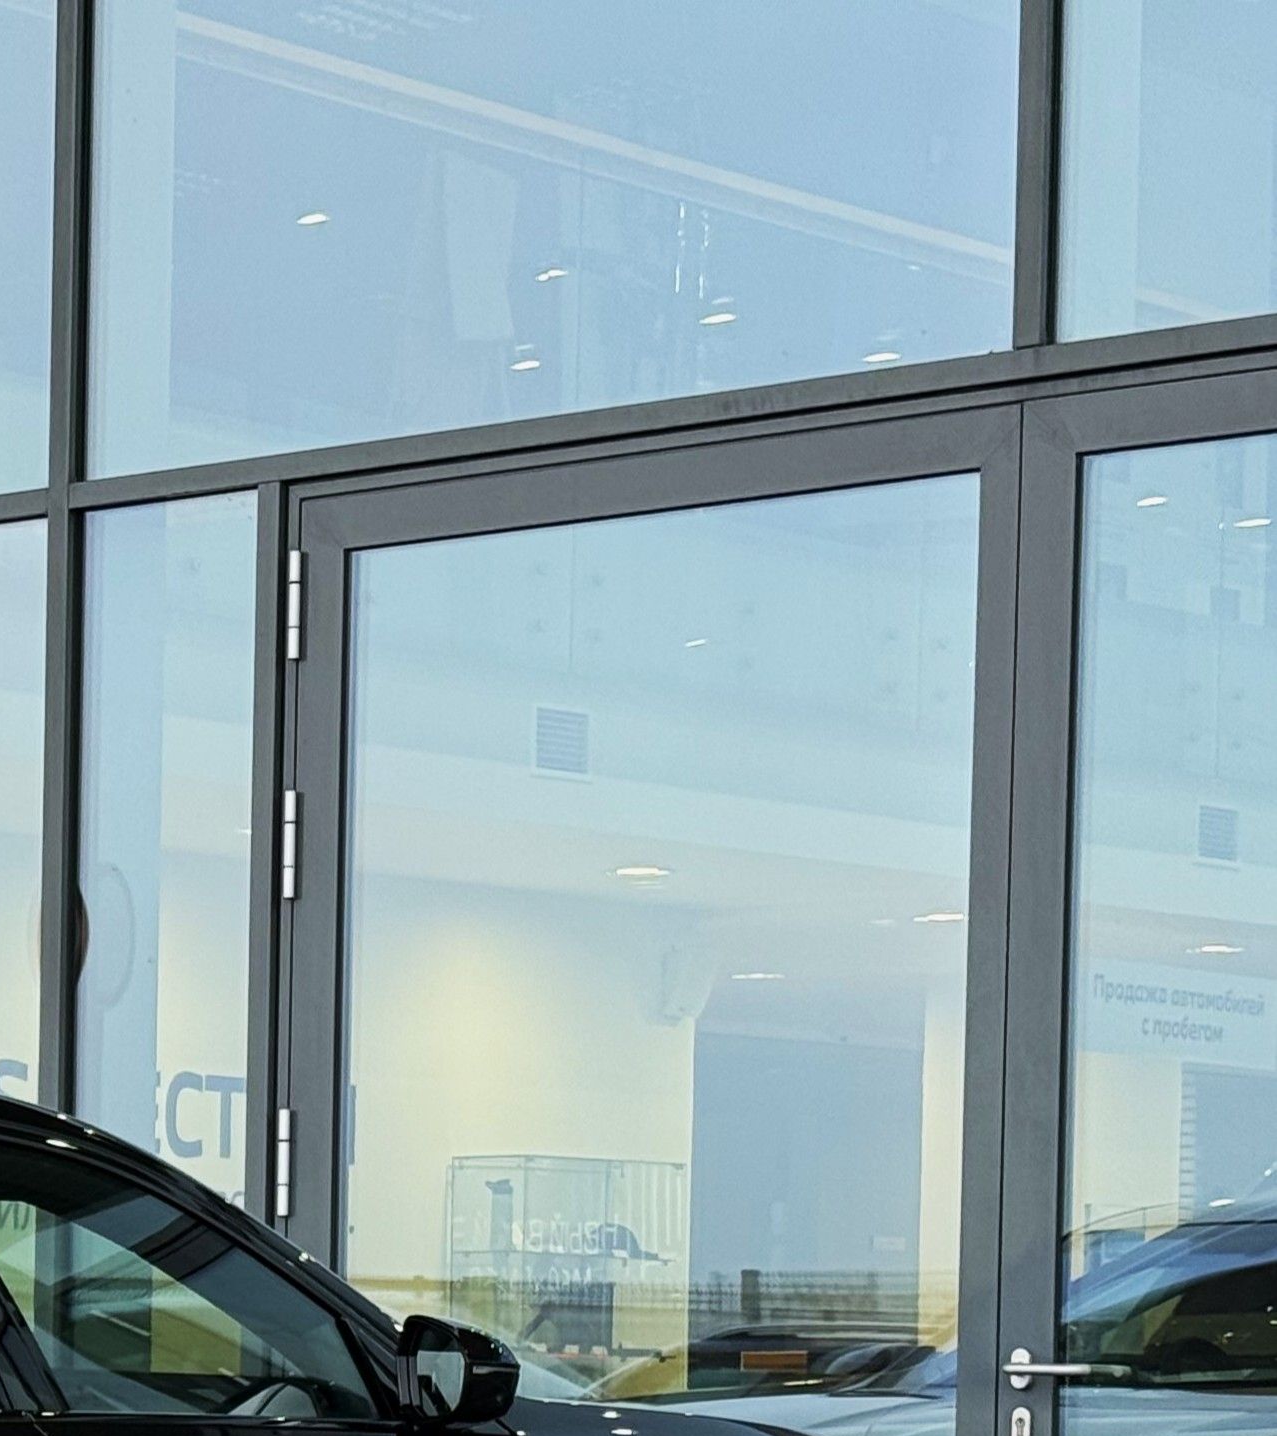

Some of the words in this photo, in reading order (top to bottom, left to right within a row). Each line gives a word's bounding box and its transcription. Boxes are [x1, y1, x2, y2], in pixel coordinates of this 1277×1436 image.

[1093, 973, 1168, 1006] Продажа
[1170, 988, 1265, 1016] автомобилей
[1141, 1016, 1150, 1036] с
[1152, 1015, 1224, 1043] пробегом
